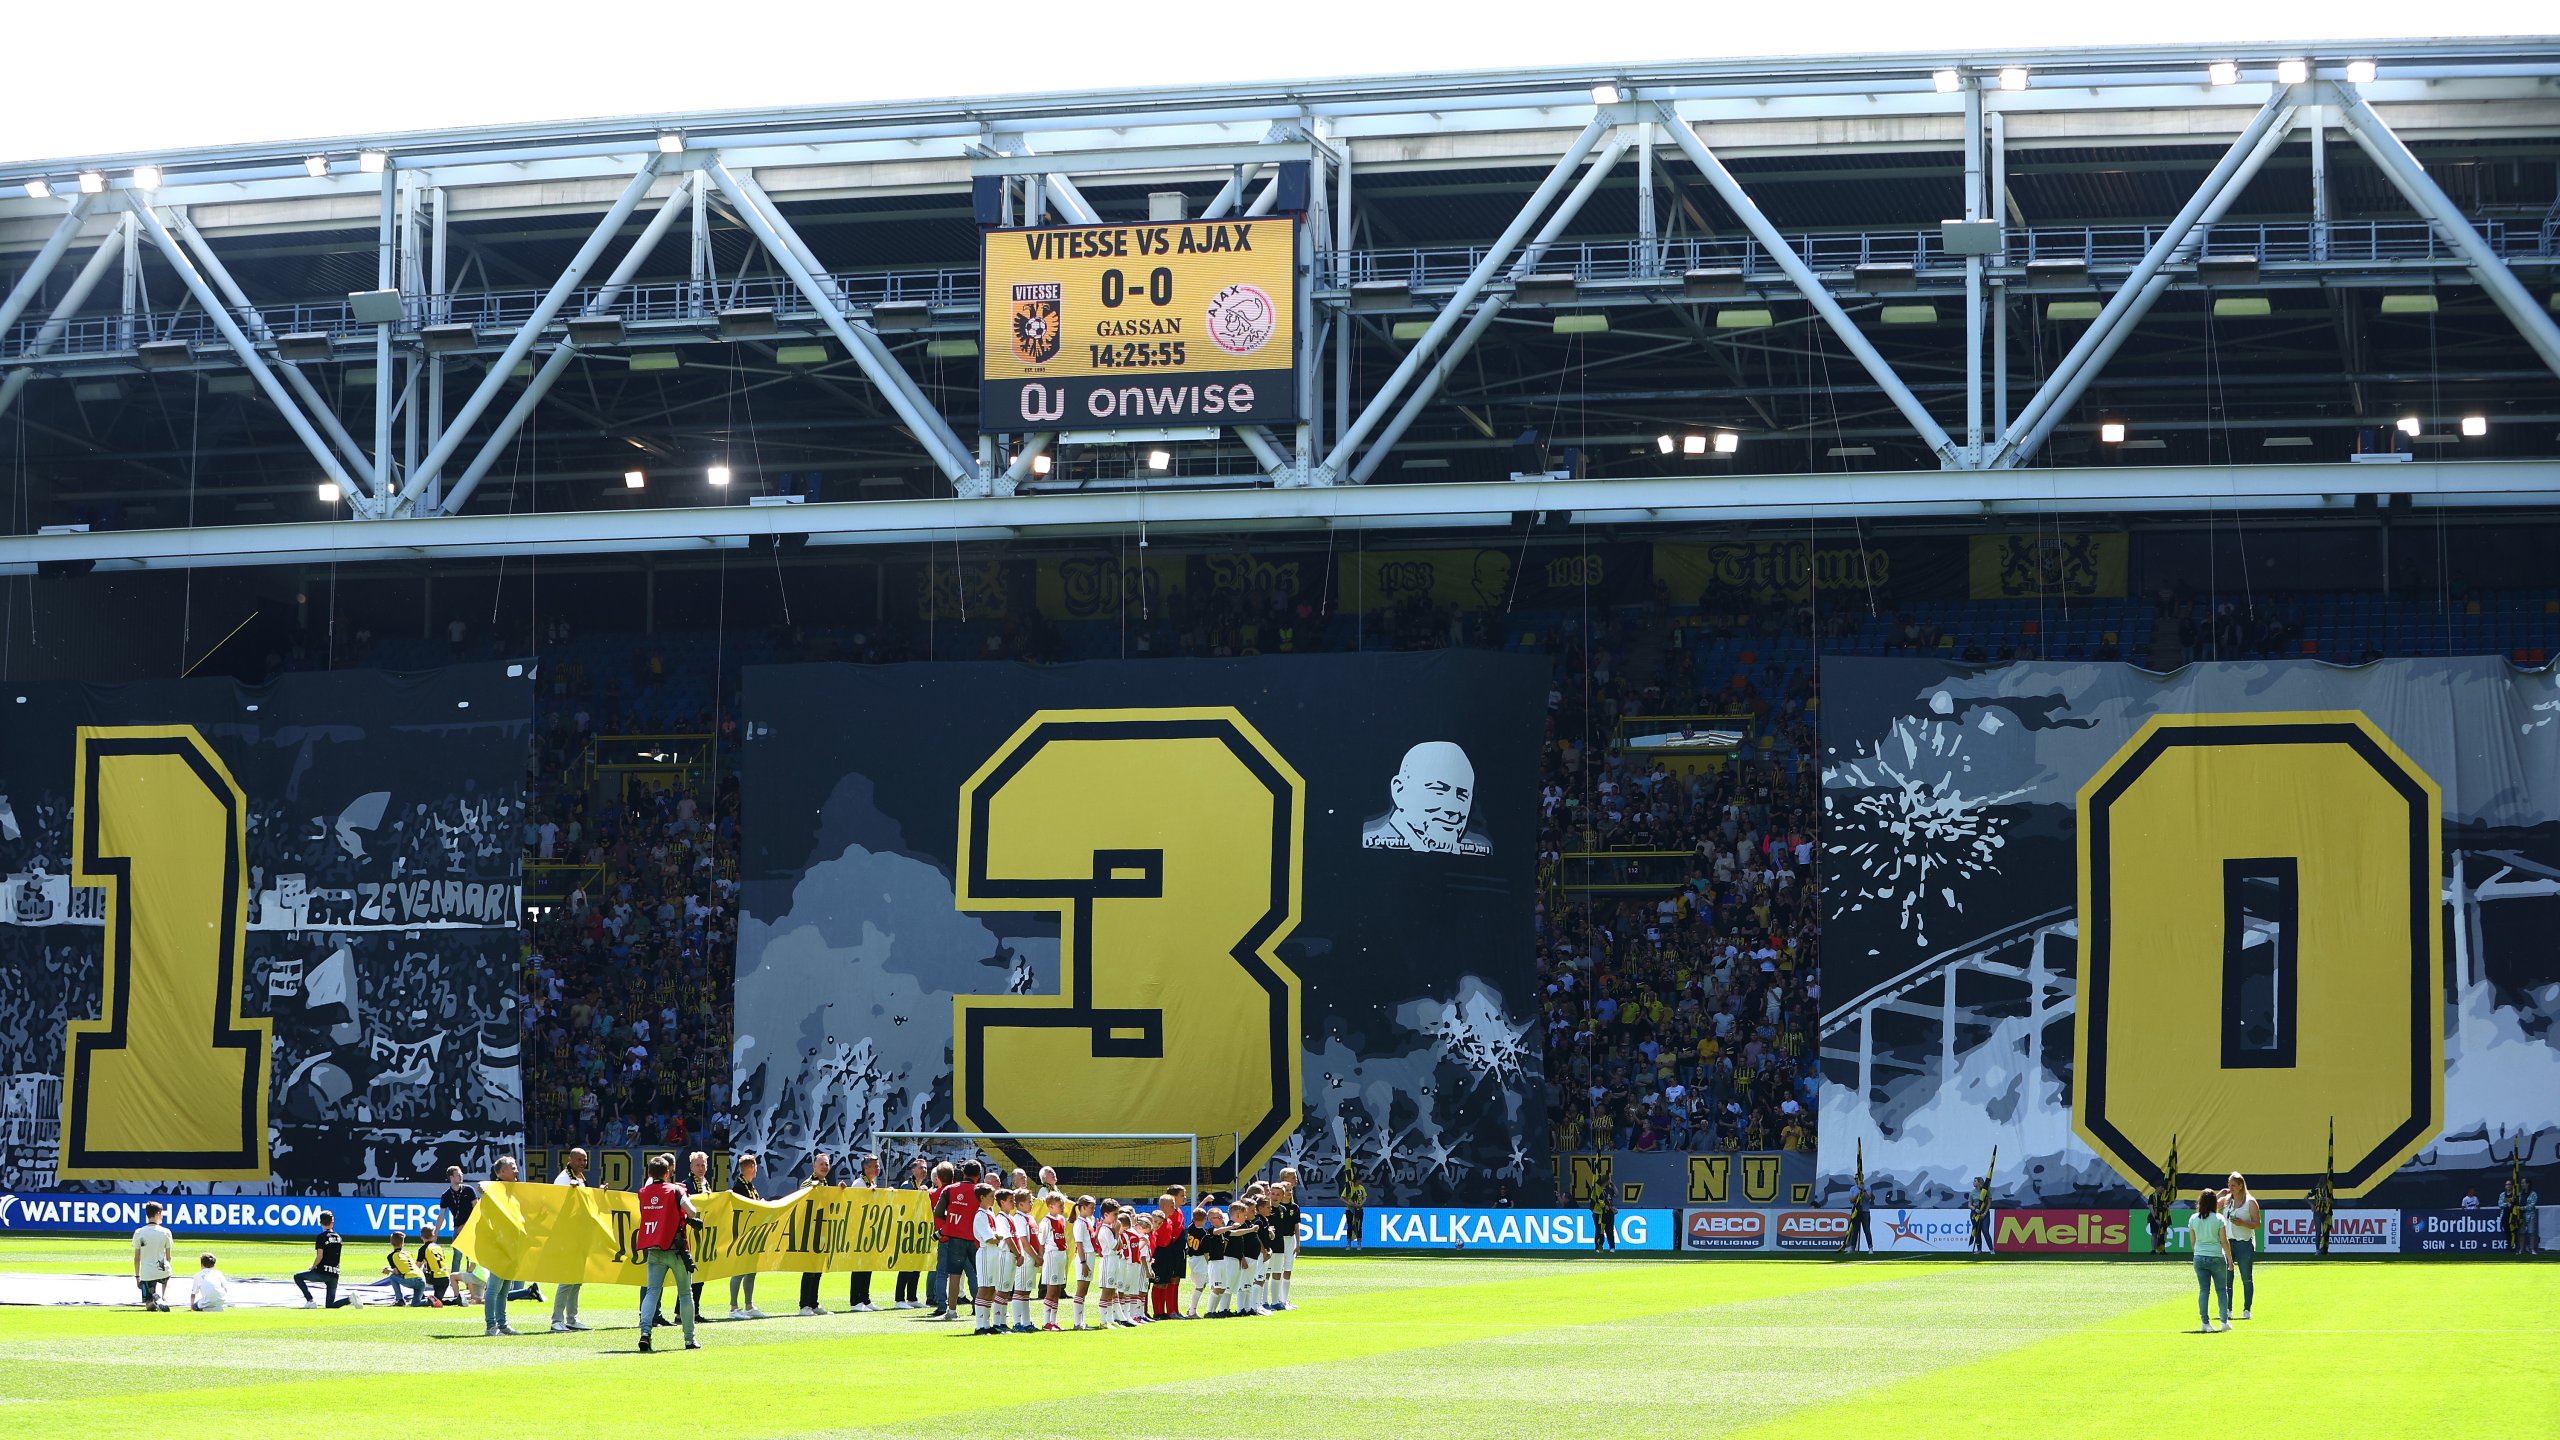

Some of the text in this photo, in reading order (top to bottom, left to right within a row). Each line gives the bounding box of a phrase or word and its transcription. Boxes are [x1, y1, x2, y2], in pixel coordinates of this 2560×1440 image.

[1026, 224, 1253, 261] VITESSE VS AJAX
[1015, 284, 1059, 301] VITESSE
[1101, 267, 1173, 308] 0-0
[1208, 285, 1240, 318] AJAX
[1096, 317, 1182, 338] GASSAN
[1089, 341, 1186, 369] 14:25:55
[1088, 382, 1255, 418] onwise
[1378, 561, 1435, 592] 1983
[1544, 554, 1604, 588] 1998
[1708, 540, 1890, 593] Tribune
[644, 1220, 658, 1234] TV
[949, 1212, 962, 1225] TV
[1693, 1216, 1761, 1232] ABCO
[1782, 1216, 1849, 1232] ABCO
[1996, 1213, 2127, 1245] Melis
[2428, 1216, 2505, 1233] Bordbust
[726, 1209, 780, 1258] Voor
[854, 1204, 893, 1253] 130
[2422, 1240, 2446, 1250] SIGN
[2460, 1240, 2478, 1250] LED
